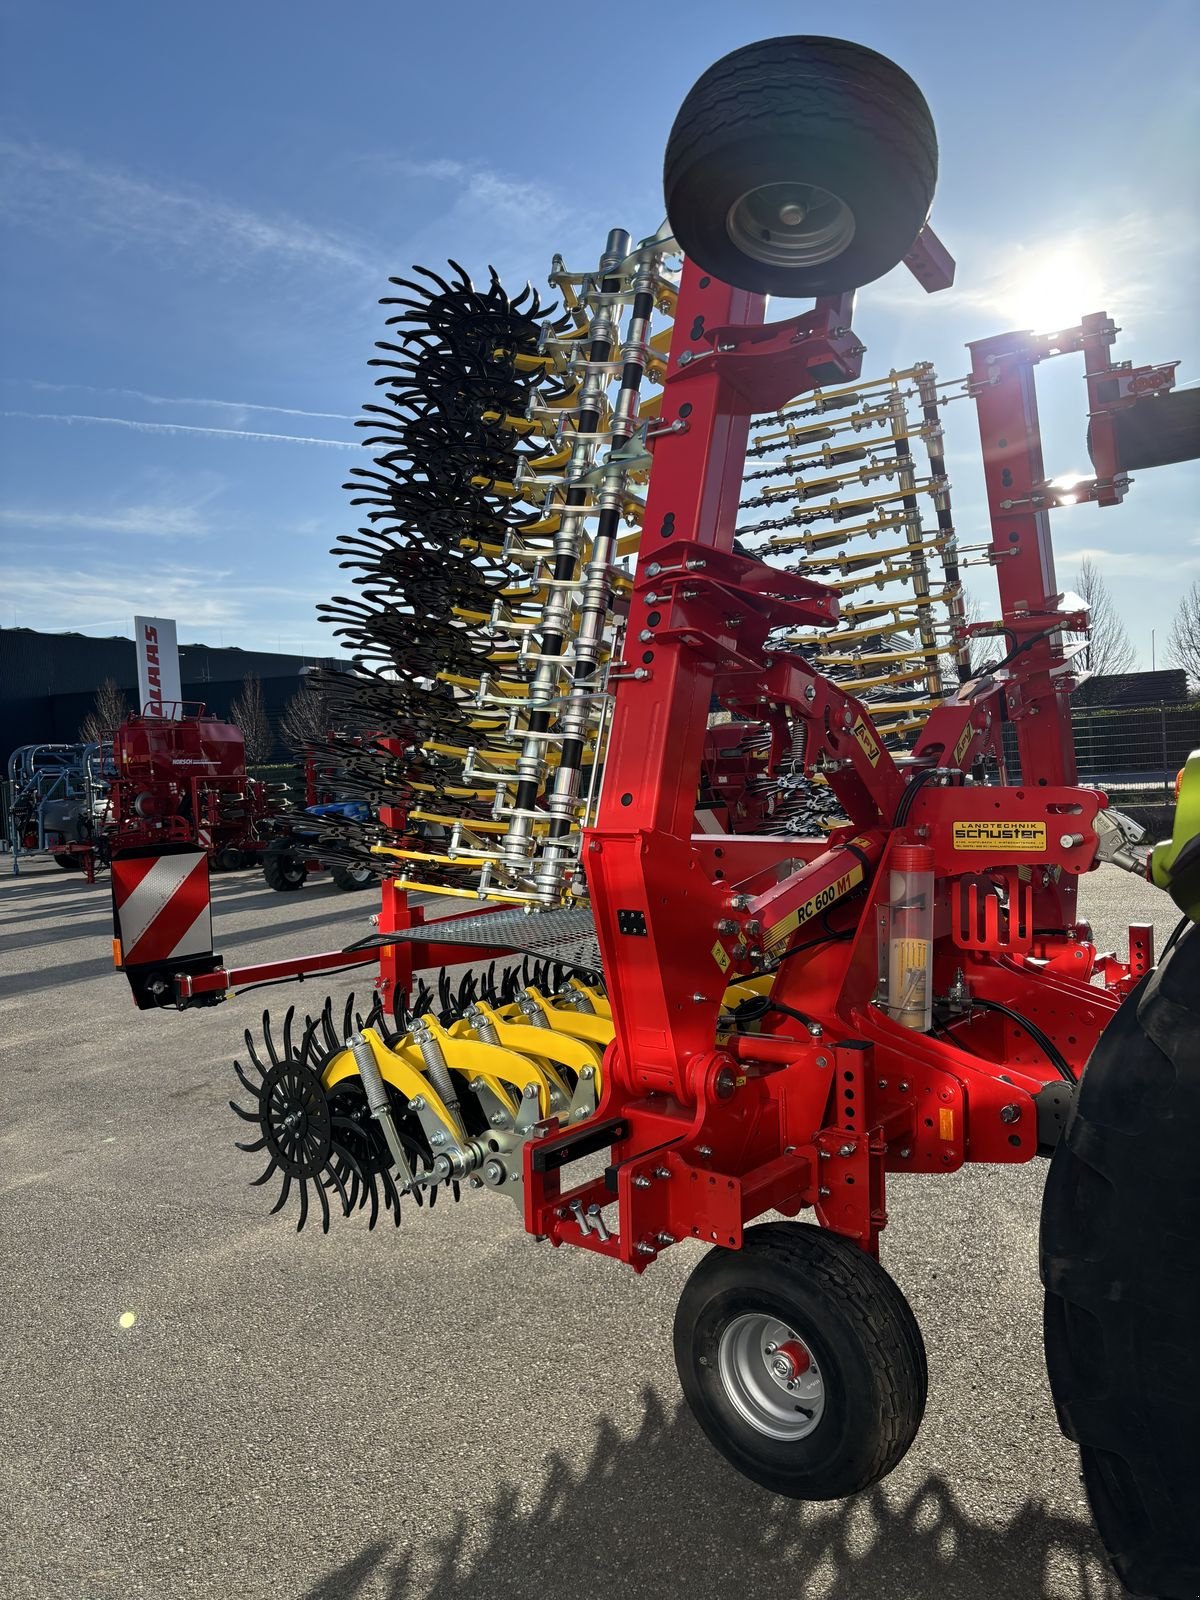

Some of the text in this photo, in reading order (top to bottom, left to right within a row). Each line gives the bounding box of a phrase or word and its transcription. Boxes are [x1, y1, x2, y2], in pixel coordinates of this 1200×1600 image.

[144, 624, 163, 718] CLAAS
[857, 727, 877, 756] APV
[955, 828, 1044, 839] schuster
[797, 874, 851, 924] RC 600 M1
